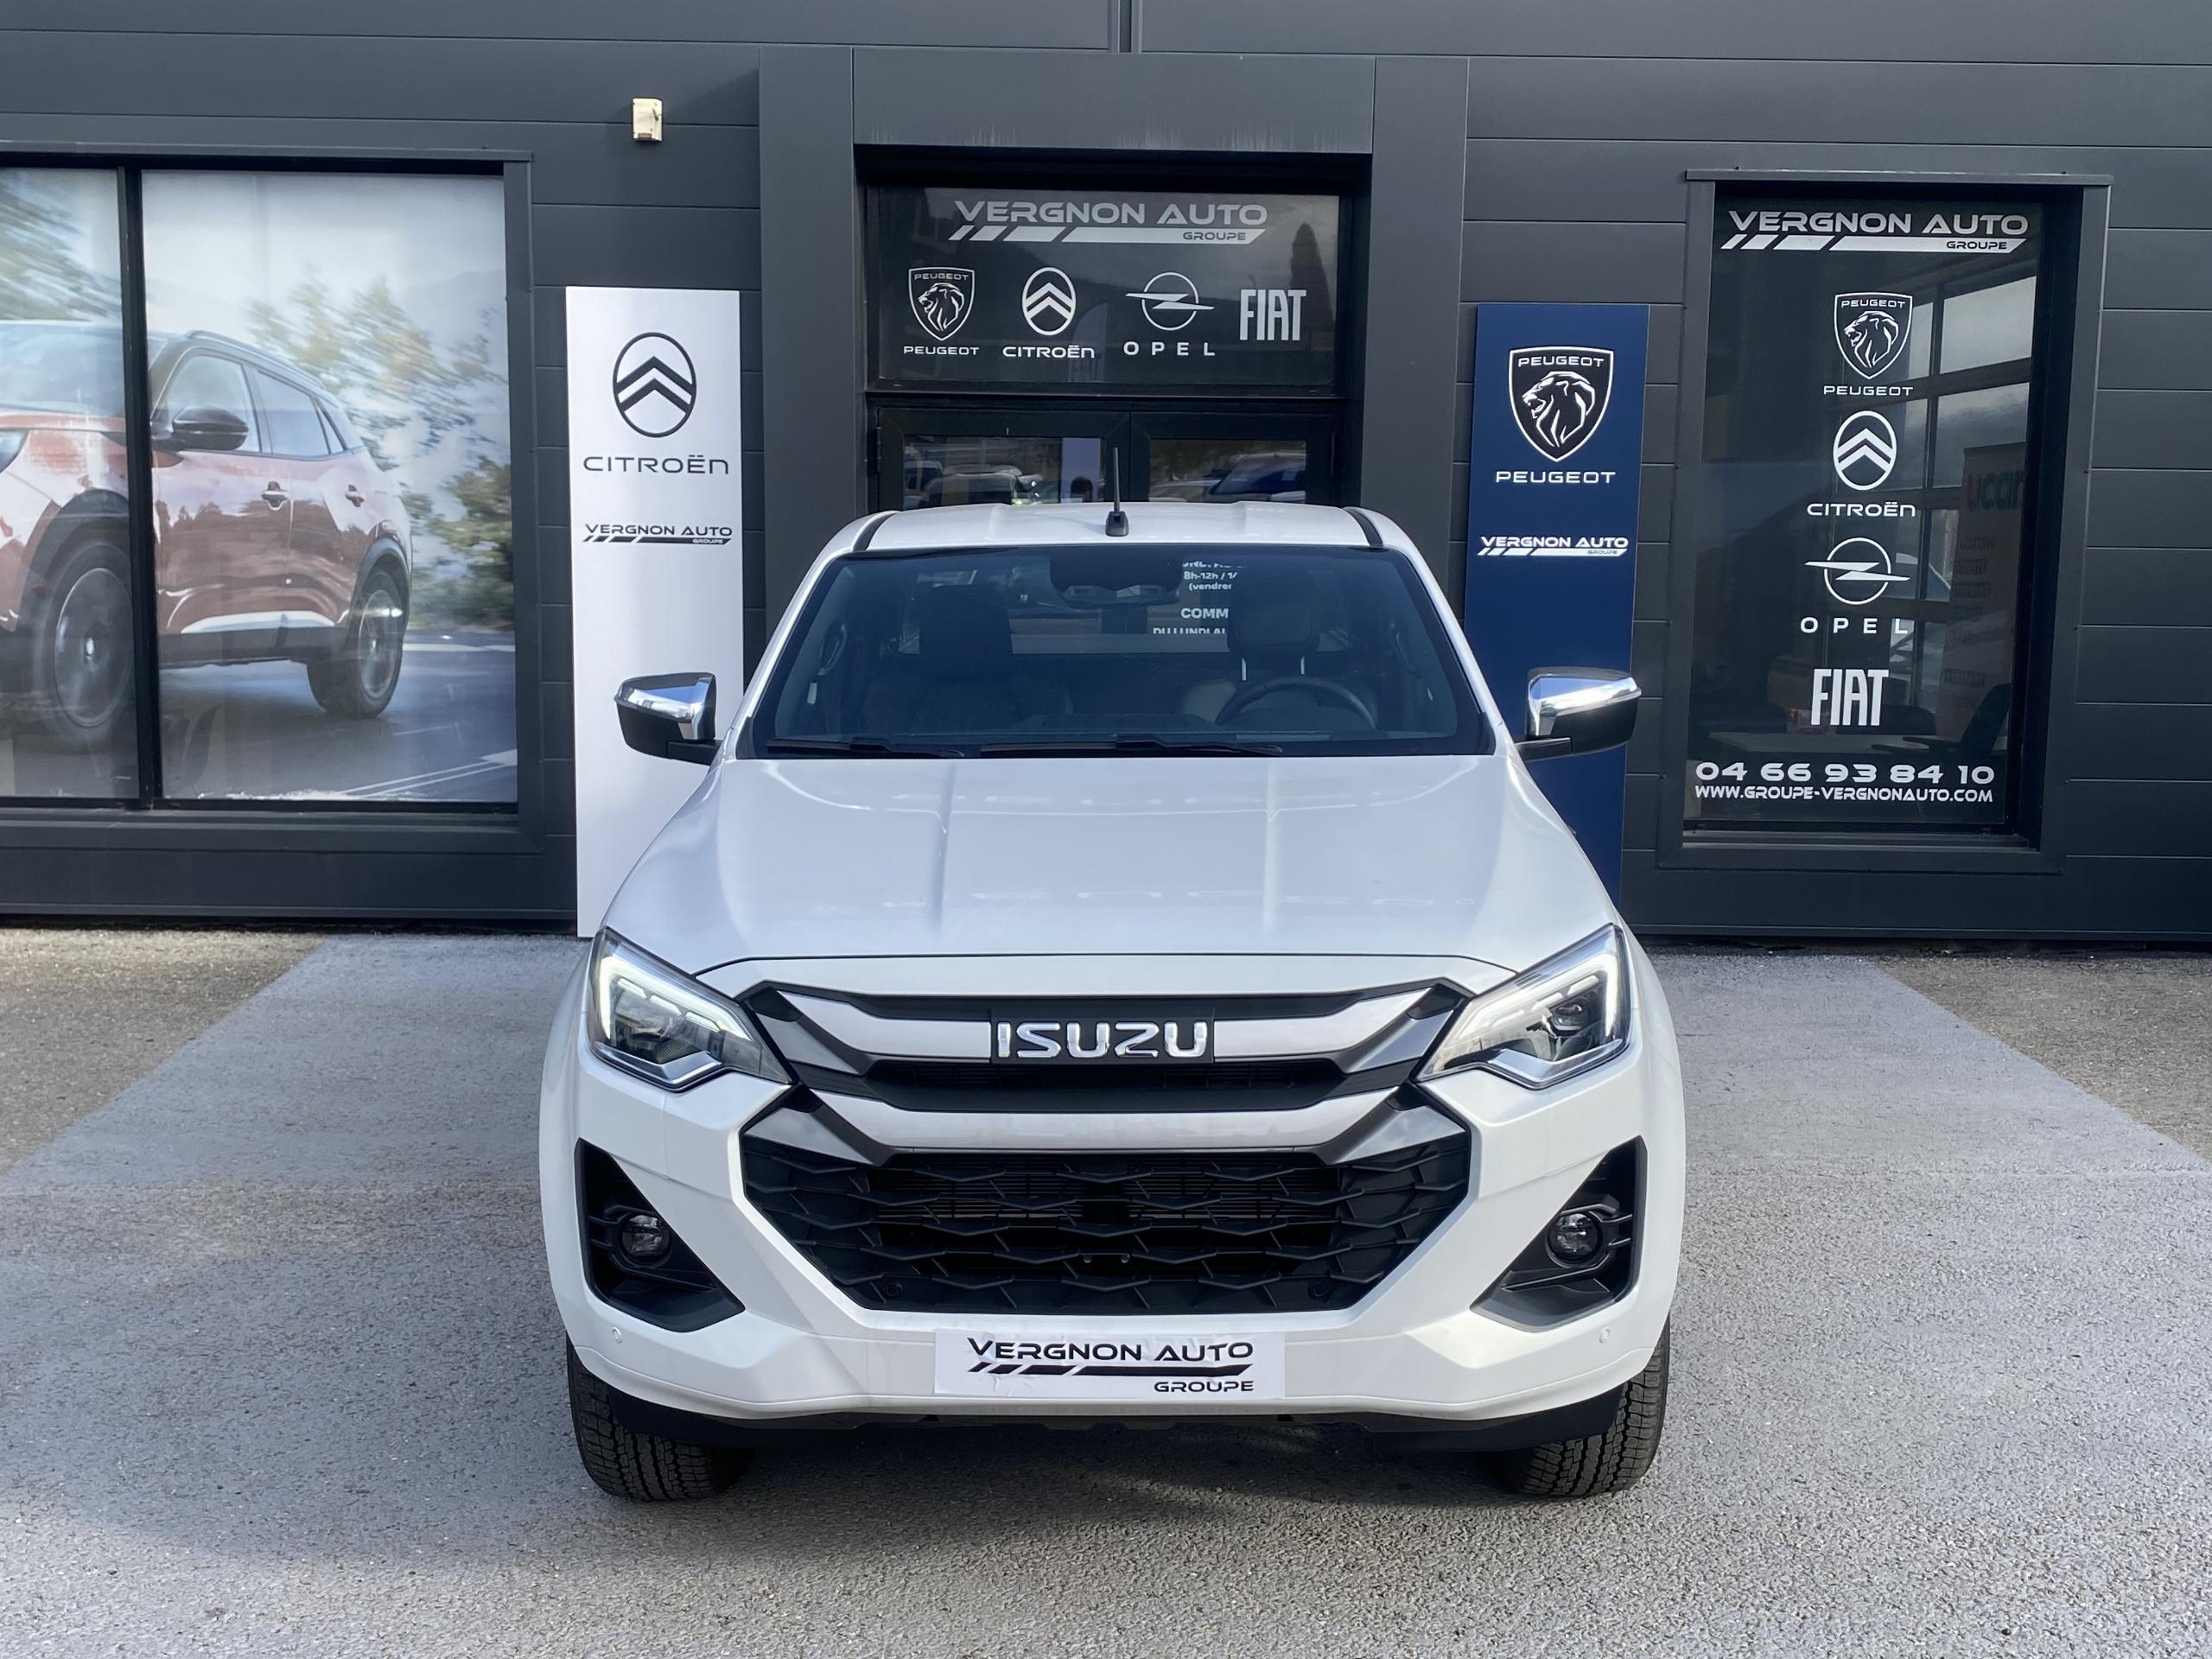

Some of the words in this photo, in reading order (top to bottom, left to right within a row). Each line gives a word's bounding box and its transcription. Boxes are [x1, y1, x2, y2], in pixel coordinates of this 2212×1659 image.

[954, 200, 1146, 225] VERGNON
[1156, 204, 1268, 226] AUTO
[1729, 210, 1911, 234] VERGNON
[1922, 213, 2029, 235] AUTO
[1182, 231, 1247, 241] GROUPE
[914, 272, 969, 283] PEUGEOT
[1840, 299, 1906, 308] PEUGEOT
[1240, 289, 1306, 340] FIAT
[903, 346, 980, 355] PEUGEOT
[1124, 341, 1215, 355] OPEL
[1517, 355, 1605, 367] PEUGEOT
[1823, 385, 1914, 396] PEUGEOT
[1496, 471, 1616, 484] PEUGEOT
[585, 524, 675, 535] VERGNON
[680, 526, 733, 536] AUTO
[1481, 537, 1571, 547] VERGNON
[1576, 537, 1629, 548] AUTO
[1183, 570, 1218, 581] 8h-12h
[1800, 617, 1909, 634] OPEL
[1811, 669, 1889, 726] FIAT
[1696, 762, 1747, 780] 04
[1761, 763, 1811, 781] 66
[1825, 764, 1877, 782] 93
[1891, 765, 1943, 783] 84
[1958, 766, 1994, 784] 10
[1694, 785, 1993, 803] WWW.GROUPE-VERGNONAUTO.COM
[996, 1021, 1209, 1058] ISUZU
[967, 1338, 1141, 1362] VERGNON
[1154, 1342, 1254, 1362] AUTO
[1154, 1380, 1254, 1393] GROUPE
